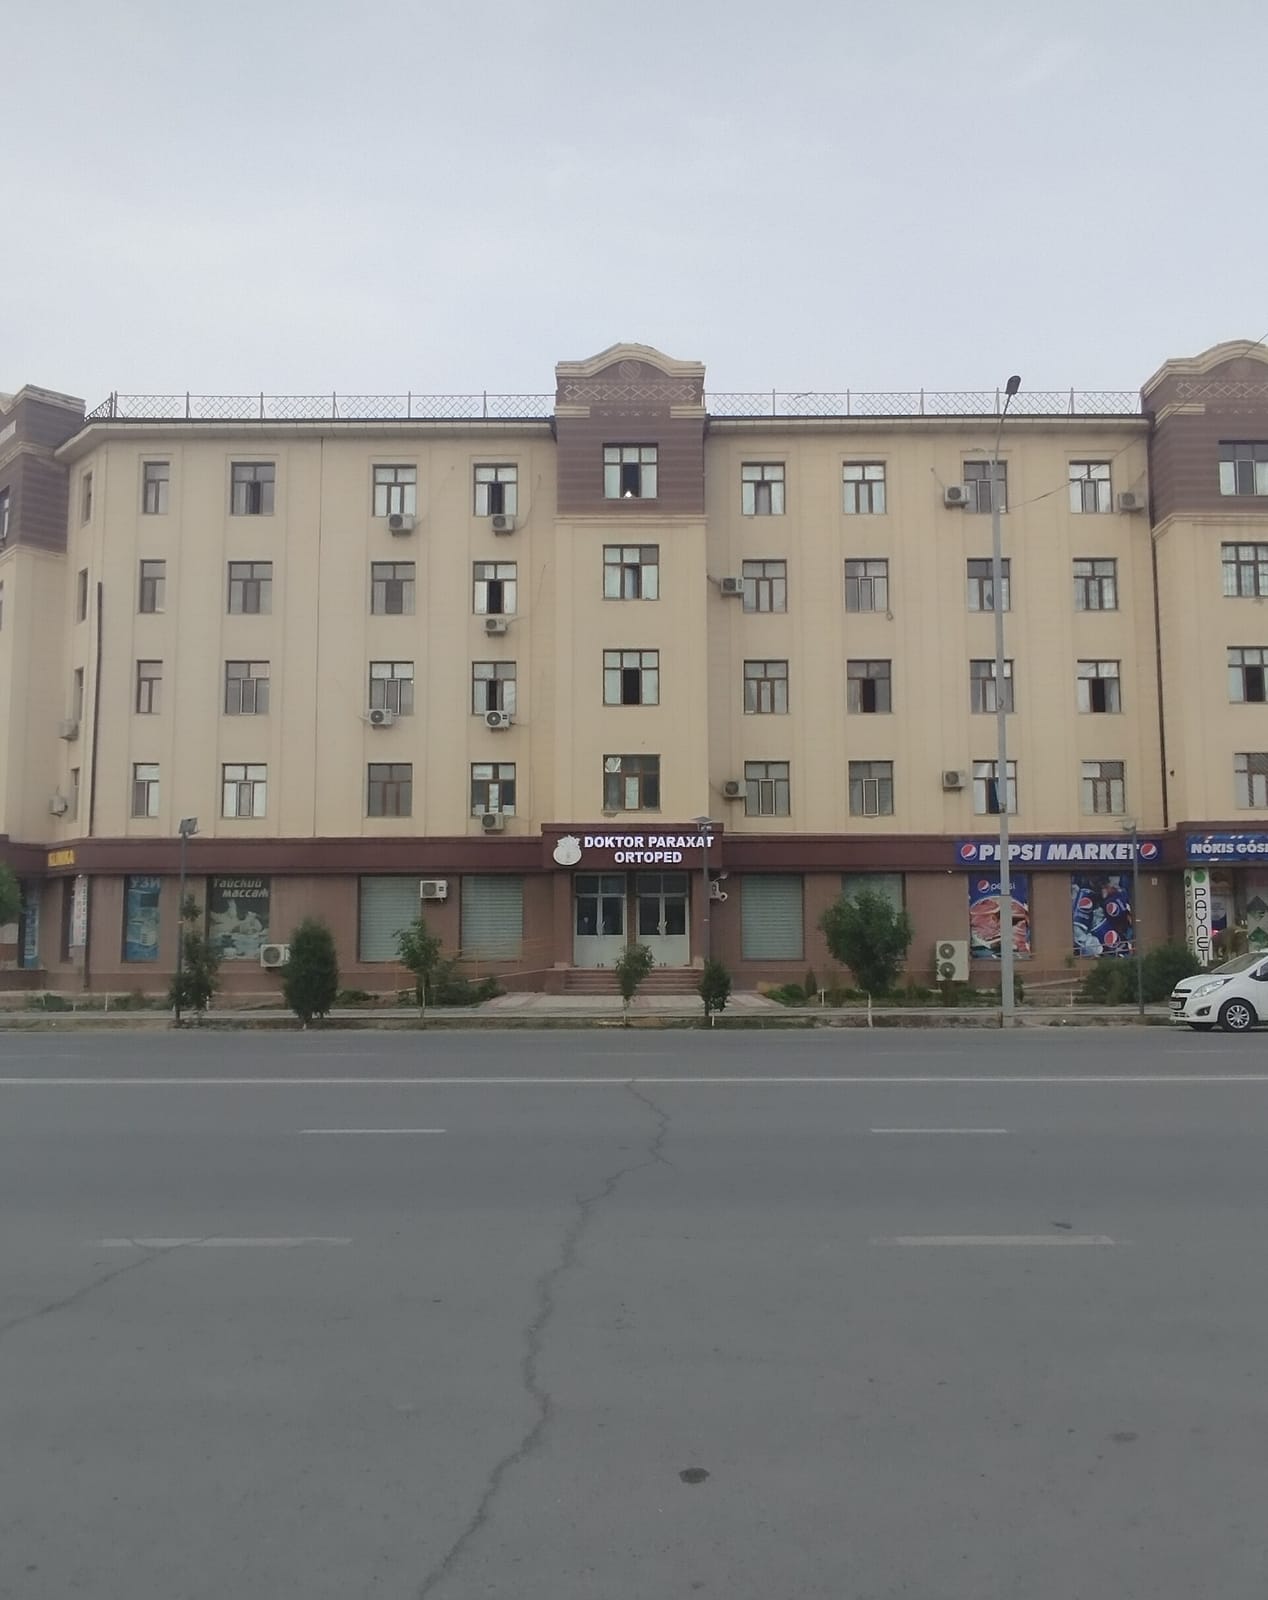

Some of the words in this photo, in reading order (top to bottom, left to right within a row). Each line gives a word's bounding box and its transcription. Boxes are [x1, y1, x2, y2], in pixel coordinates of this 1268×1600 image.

[584, 836, 644, 848] DOKTOR
[648, 836, 714, 848] PARAXAT
[614, 851, 682, 863] ORTOPED
[1047, 843, 1140, 860] MARKET
[130, 876, 161, 889] УЗИ
[990, 880, 1016, 892] pesi
[222, 888, 269, 898] массаж
[1194, 888, 1209, 961] PAYNET
